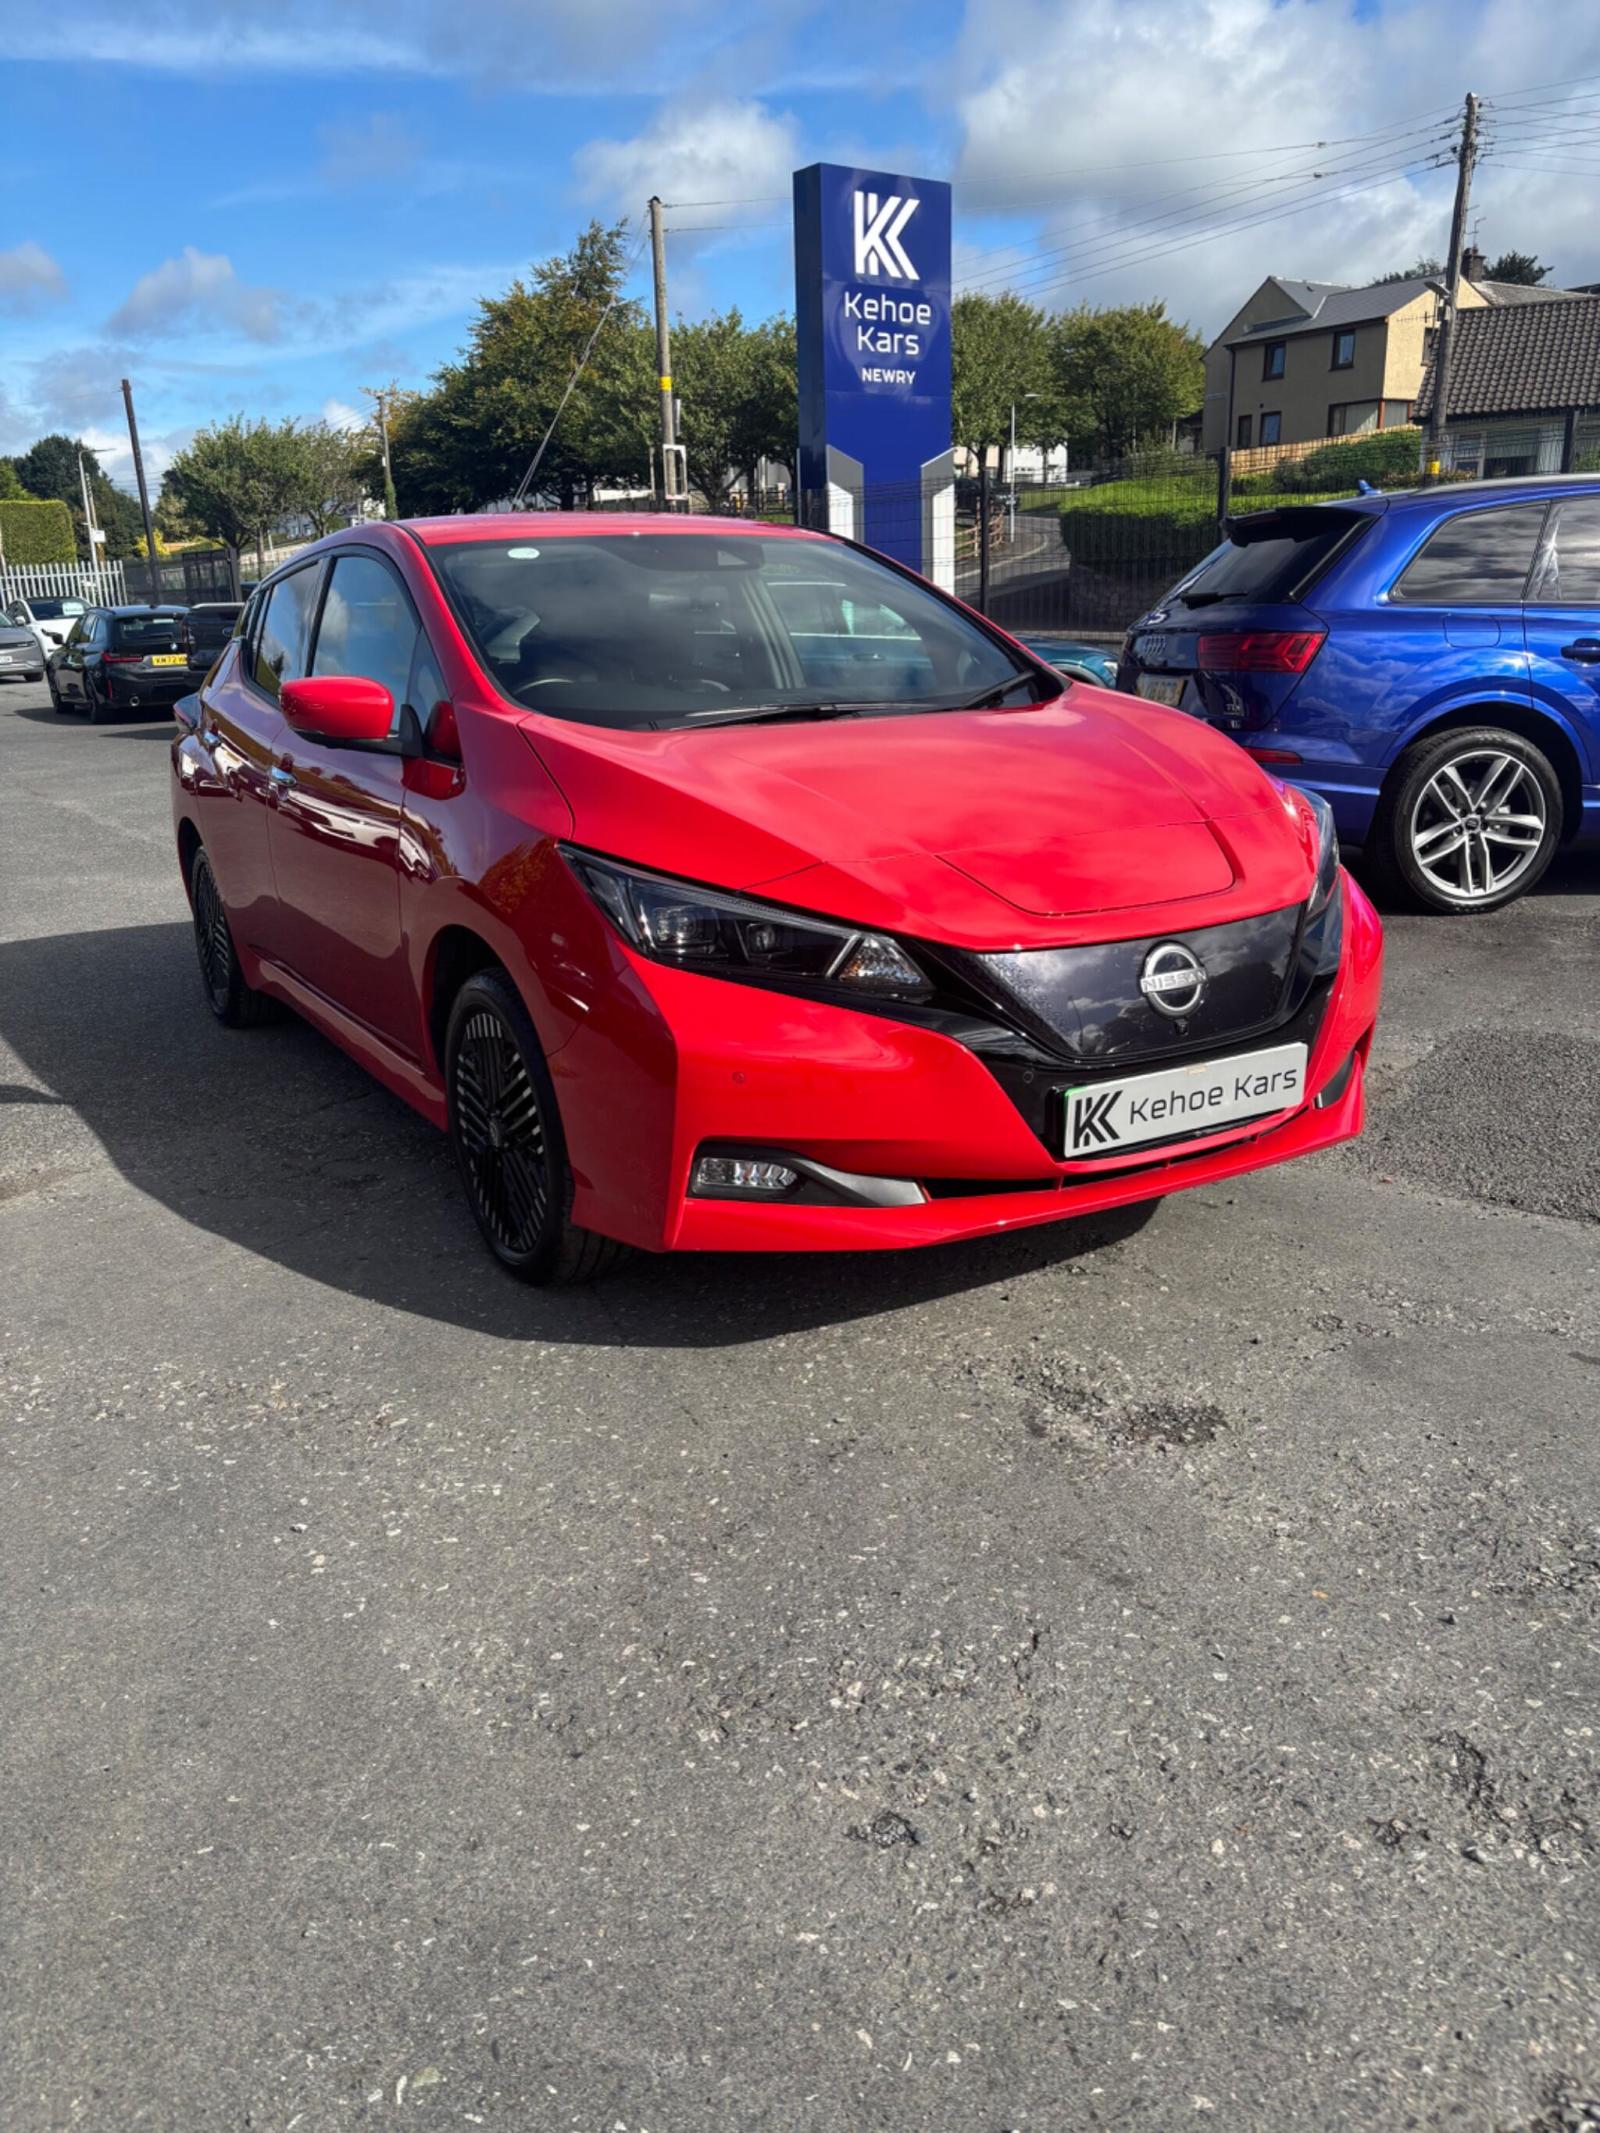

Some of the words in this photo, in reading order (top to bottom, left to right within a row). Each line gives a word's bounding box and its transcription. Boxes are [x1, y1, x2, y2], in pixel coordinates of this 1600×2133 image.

[845, 292, 931, 324] Kehoe
[857, 326, 919, 355] Kars
[861, 368, 916, 385] NEWRY
[1141, 970, 1207, 991] NISSAN
[1129, 1086, 1223, 1125] Kehoe
[1234, 1069, 1297, 1100] Kars
